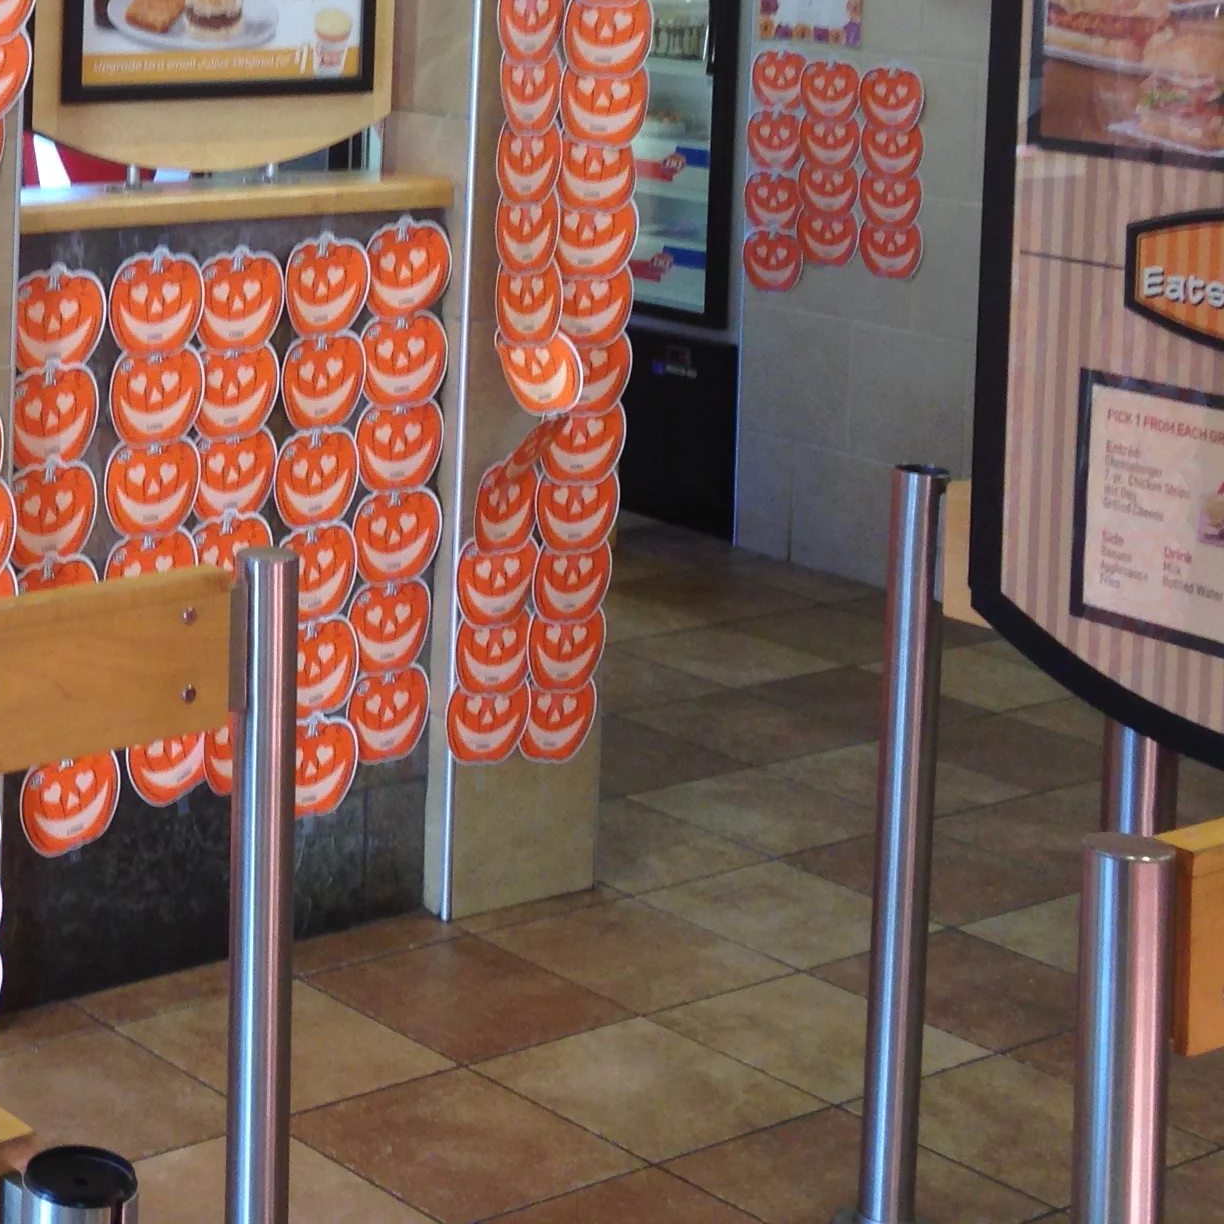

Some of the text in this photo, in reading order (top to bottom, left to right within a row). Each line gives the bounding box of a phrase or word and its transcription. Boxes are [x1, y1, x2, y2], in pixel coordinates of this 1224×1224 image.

[1107, 408, 1133, 425] PICK
[1143, 415, 1175, 434] FROM
[1177, 422, 1208, 441] EACH
